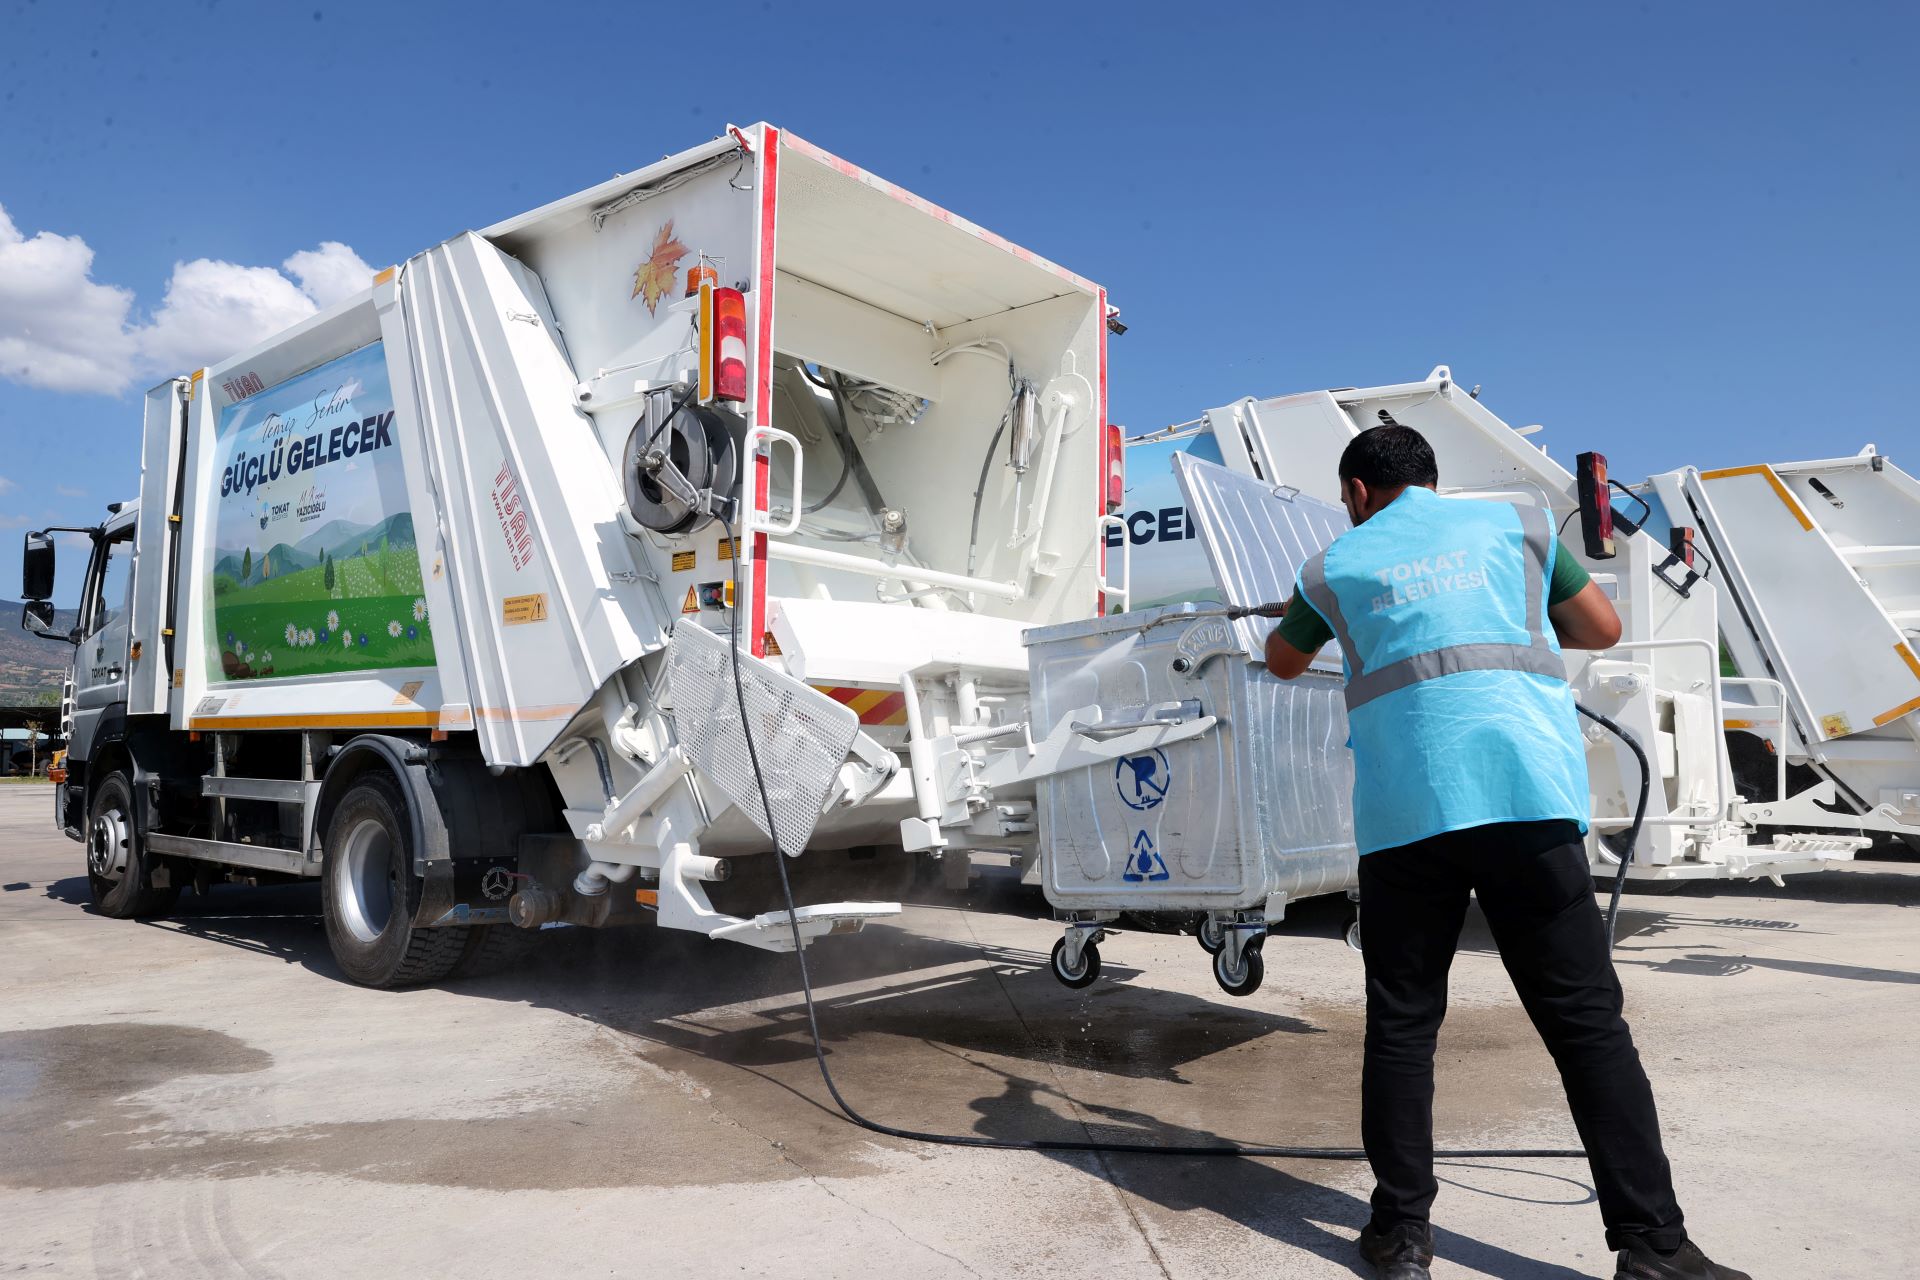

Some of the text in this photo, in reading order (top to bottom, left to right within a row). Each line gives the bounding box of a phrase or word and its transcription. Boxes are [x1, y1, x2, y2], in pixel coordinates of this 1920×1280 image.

[220, 410, 395, 498] GÜÇLÜ GELECEK
[271, 502, 290, 515] TOKAT
[491, 489, 521, 572] www.tisan.eu
[1375, 550, 1469, 586] TOKAT
[91, 667, 107, 679] TOKAT
